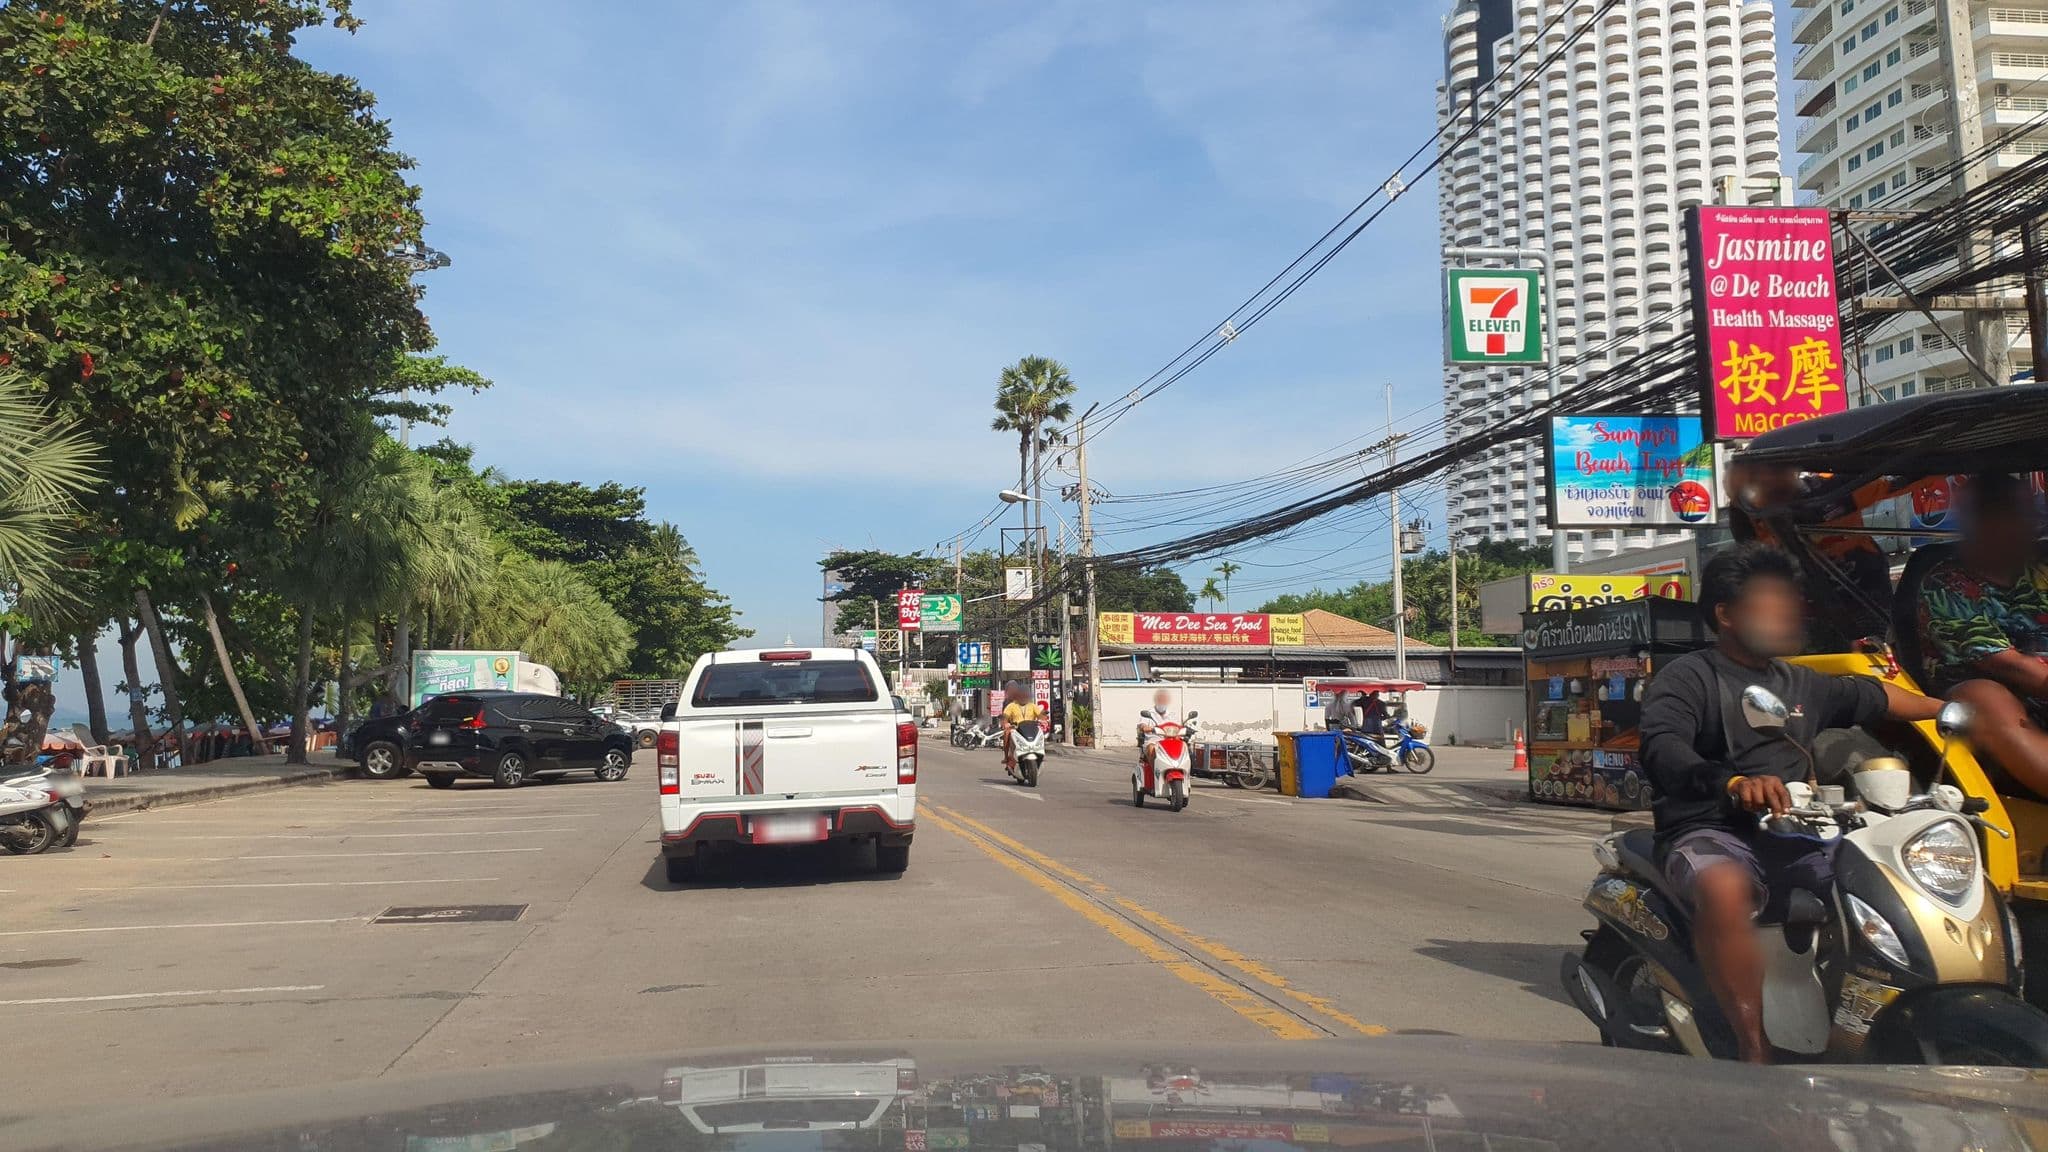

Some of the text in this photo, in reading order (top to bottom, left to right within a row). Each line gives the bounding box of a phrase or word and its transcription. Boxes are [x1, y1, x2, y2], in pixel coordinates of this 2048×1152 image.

[1707, 233, 1826, 269] Jasmine
[1710, 273, 1830, 298] @ De Beach
[1470, 288, 1518, 354] 7
[1712, 309, 1834, 332] Health Massage
[1719, 336, 1840, 410] 按摩
[1591, 422, 1677, 447] Summer
[1576, 450, 1685, 477] Beach Inn
[1141, 616, 1262, 633] Mee Dee Sea Food
[1307, 694, 1318, 706] P
